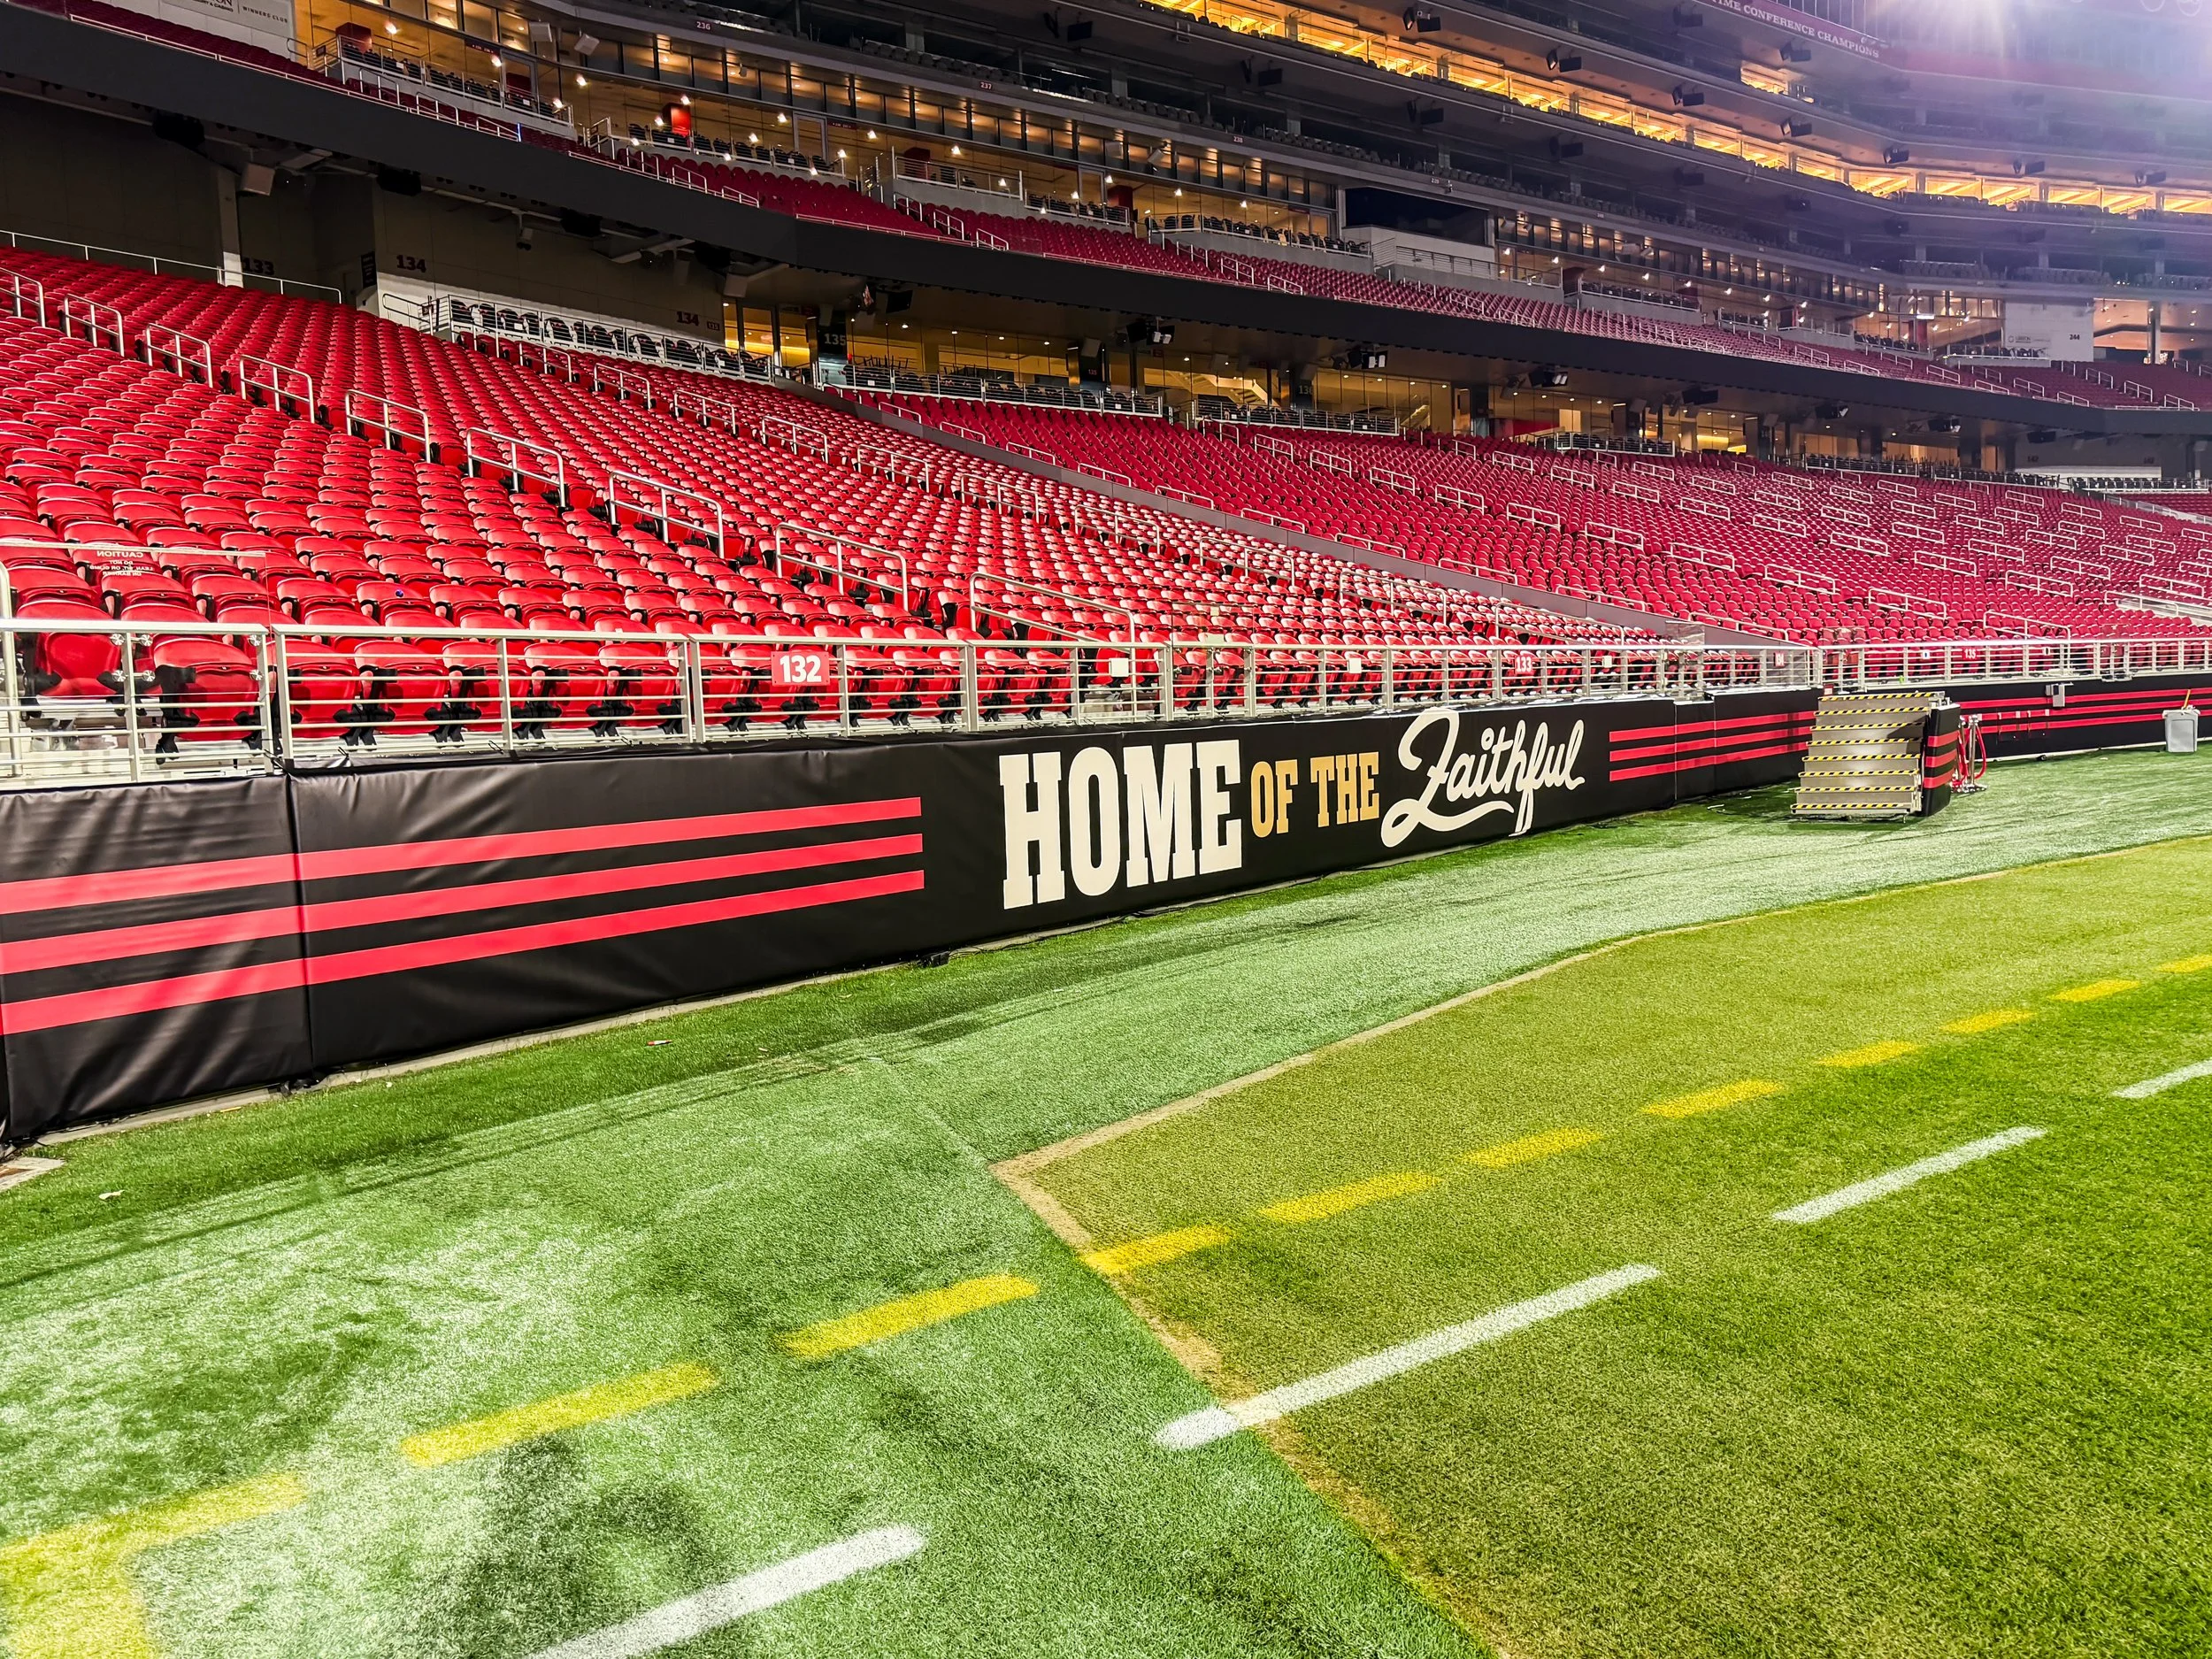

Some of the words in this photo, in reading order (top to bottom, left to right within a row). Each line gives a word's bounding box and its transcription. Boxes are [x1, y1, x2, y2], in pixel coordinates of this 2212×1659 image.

[242, 6, 271, 18] WINNERS
[273, 14, 288, 23] CLUB
[696, 21, 710, 30] 236
[1743, 4, 1815, 36] CONFERENCE
[1817, 31, 1879, 58] CHAMPIONS
[242, 257, 274, 275] 133
[396, 255, 426, 273] 134
[677, 311, 700, 326] 134
[824, 333, 846, 346] 135
[1964, 649, 1976, 659] 135
[780, 655, 822, 683] 132
[1516, 656, 1532, 672] 133
[999, 738, 1242, 910] HOME
[1250, 758, 1298, 838] OF
[1310, 751, 1380, 827] THE
[1380, 706, 1586, 848] Faithful
